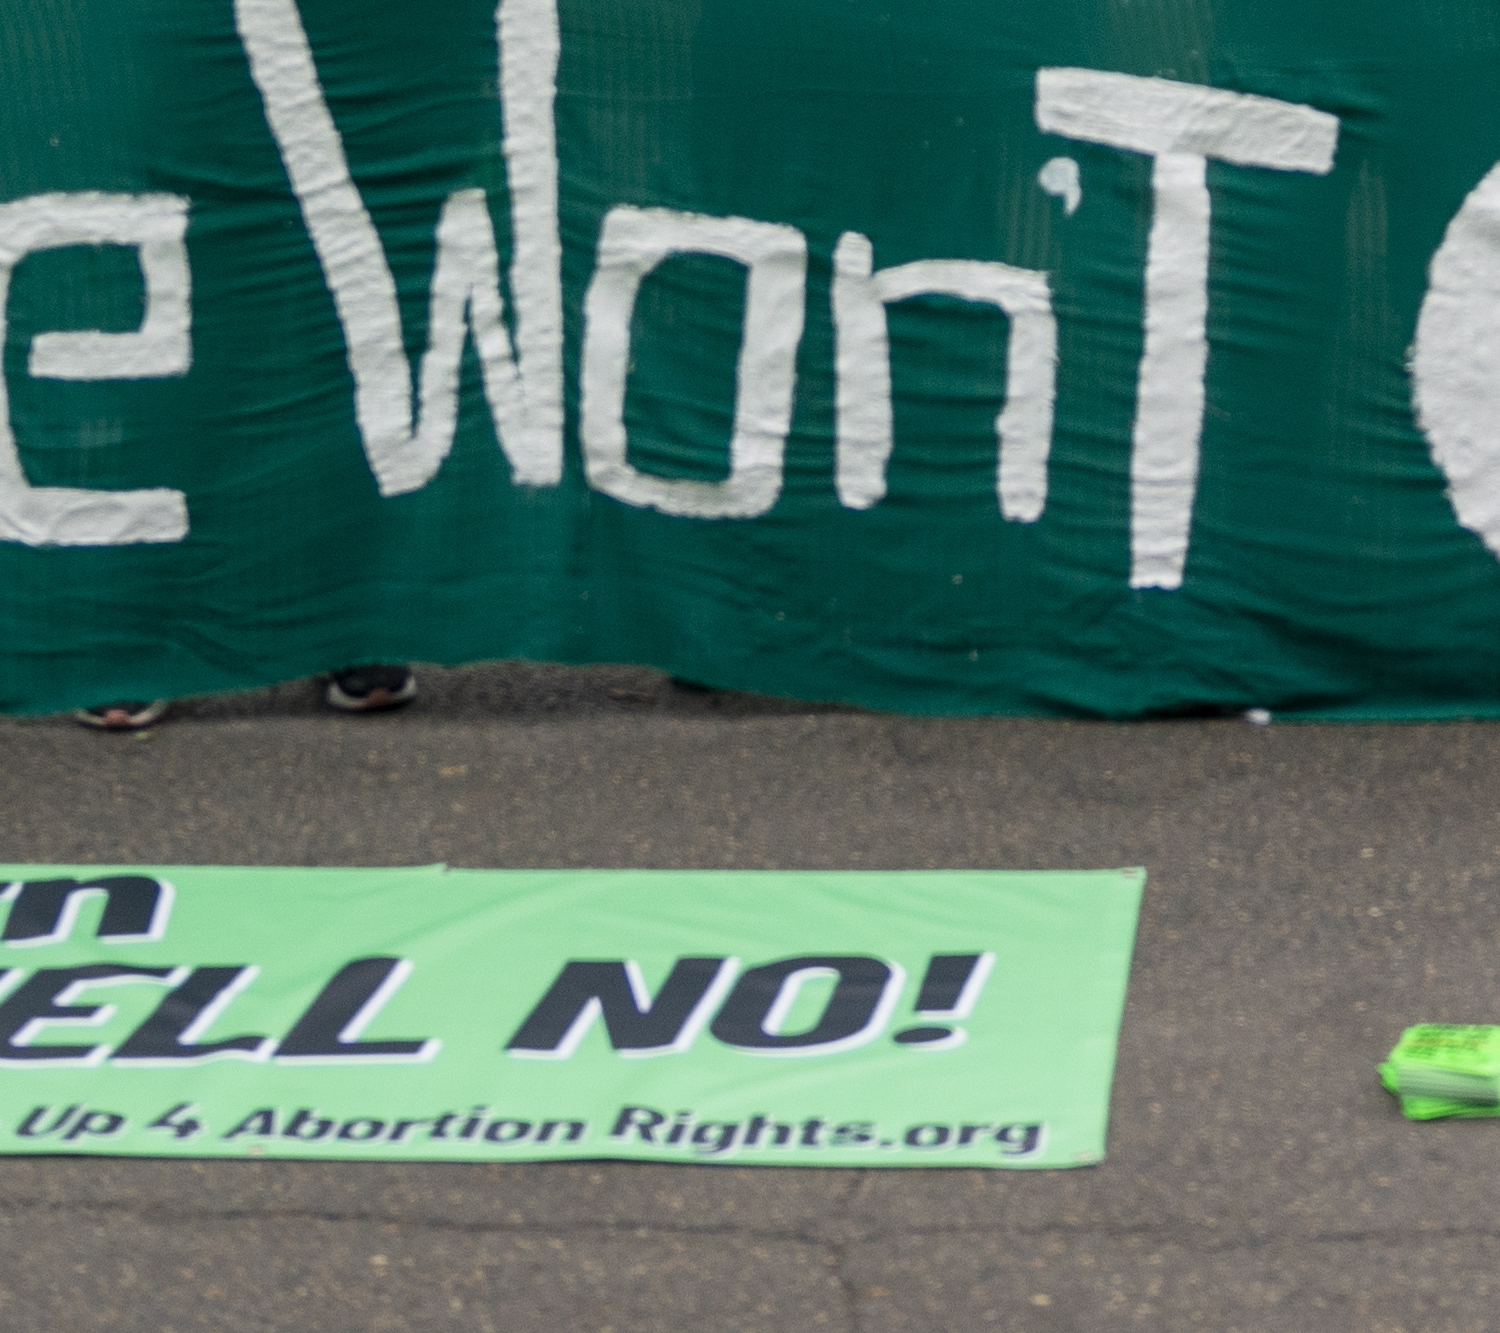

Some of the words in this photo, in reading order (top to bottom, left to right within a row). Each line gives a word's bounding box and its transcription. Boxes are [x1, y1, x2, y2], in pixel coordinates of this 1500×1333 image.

[504, 951, 996, 1059] NO!
[22, 1104, 126, 1147] Up
[151, 1106, 205, 1139] 4
[216, 1106, 588, 1147] Abortion
[612, 1105, 1046, 1158] Rights.org
